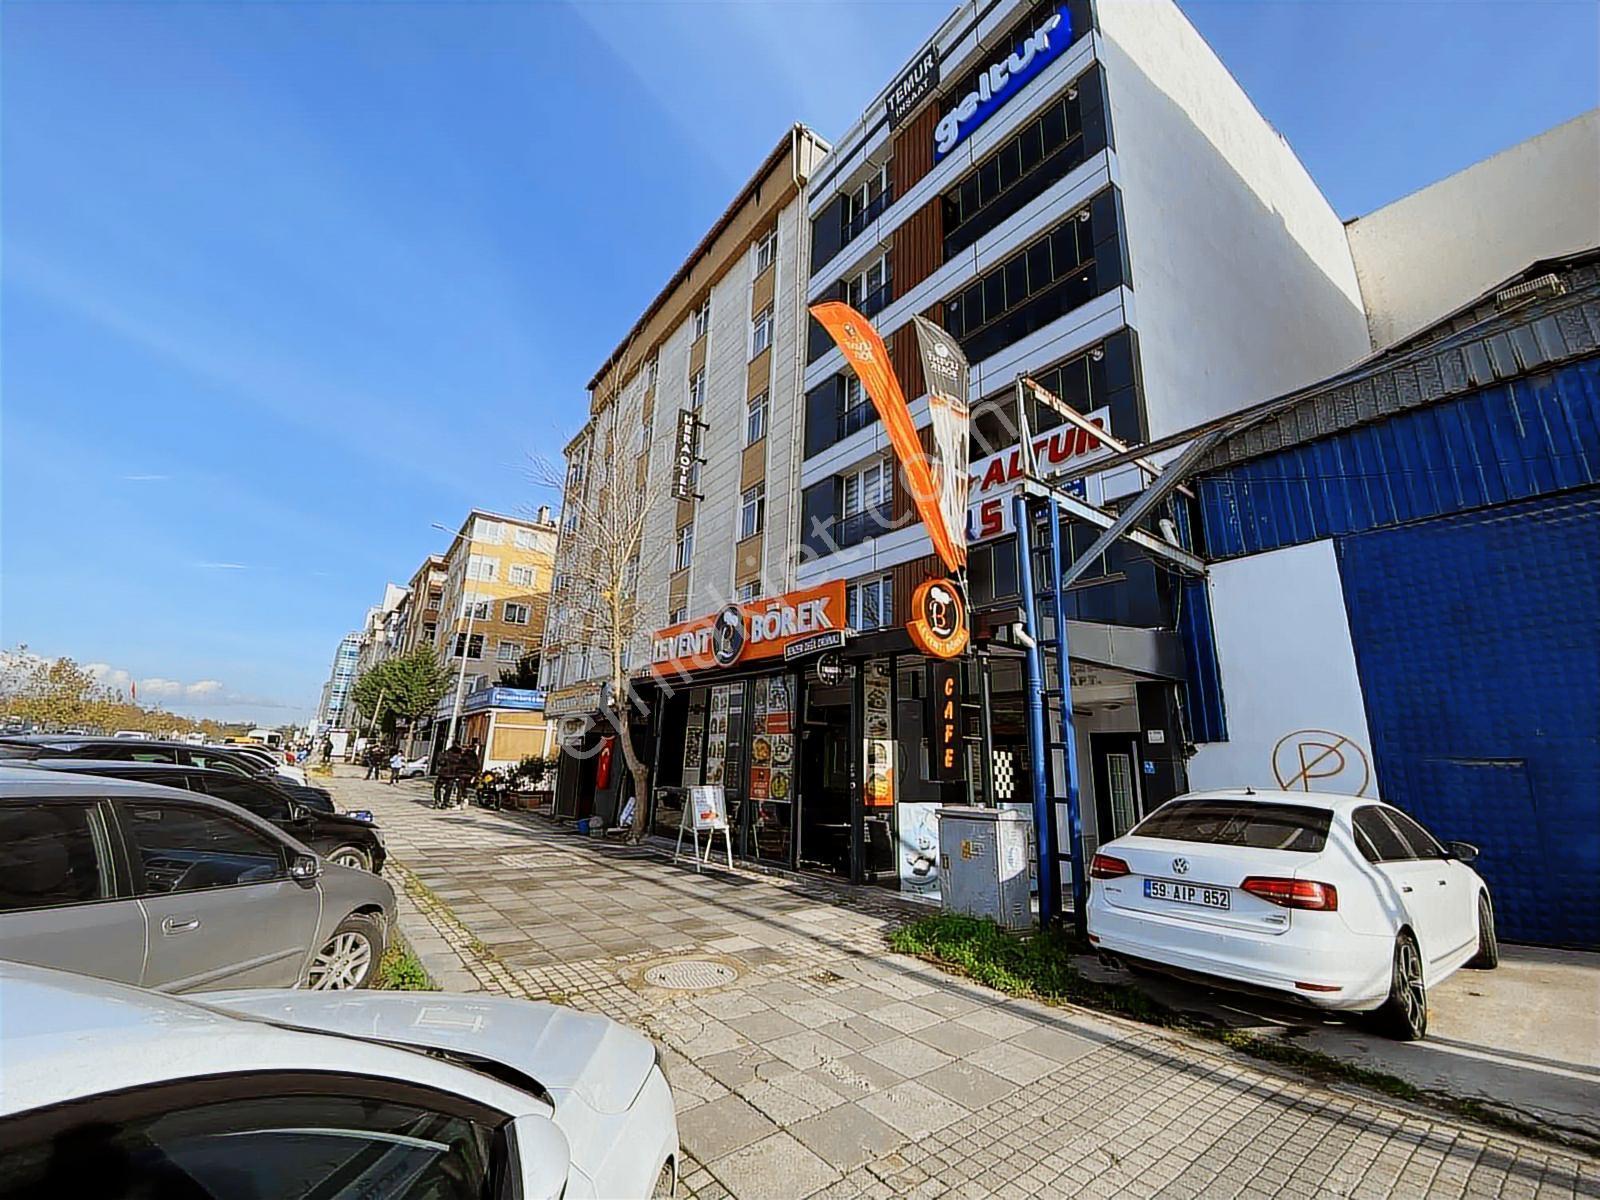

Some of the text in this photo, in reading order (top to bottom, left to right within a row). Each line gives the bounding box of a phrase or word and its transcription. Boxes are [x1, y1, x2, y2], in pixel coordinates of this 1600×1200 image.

[887, 54, 934, 111] TEMUR
[935, 14, 1061, 153] geltur
[679, 414, 693, 496] HERA OTEL
[653, 597, 833, 663] LEVENT BÖREK
[944, 678, 955, 768] CAFE
[1151, 882, 1228, 907] 59 AIP 852
